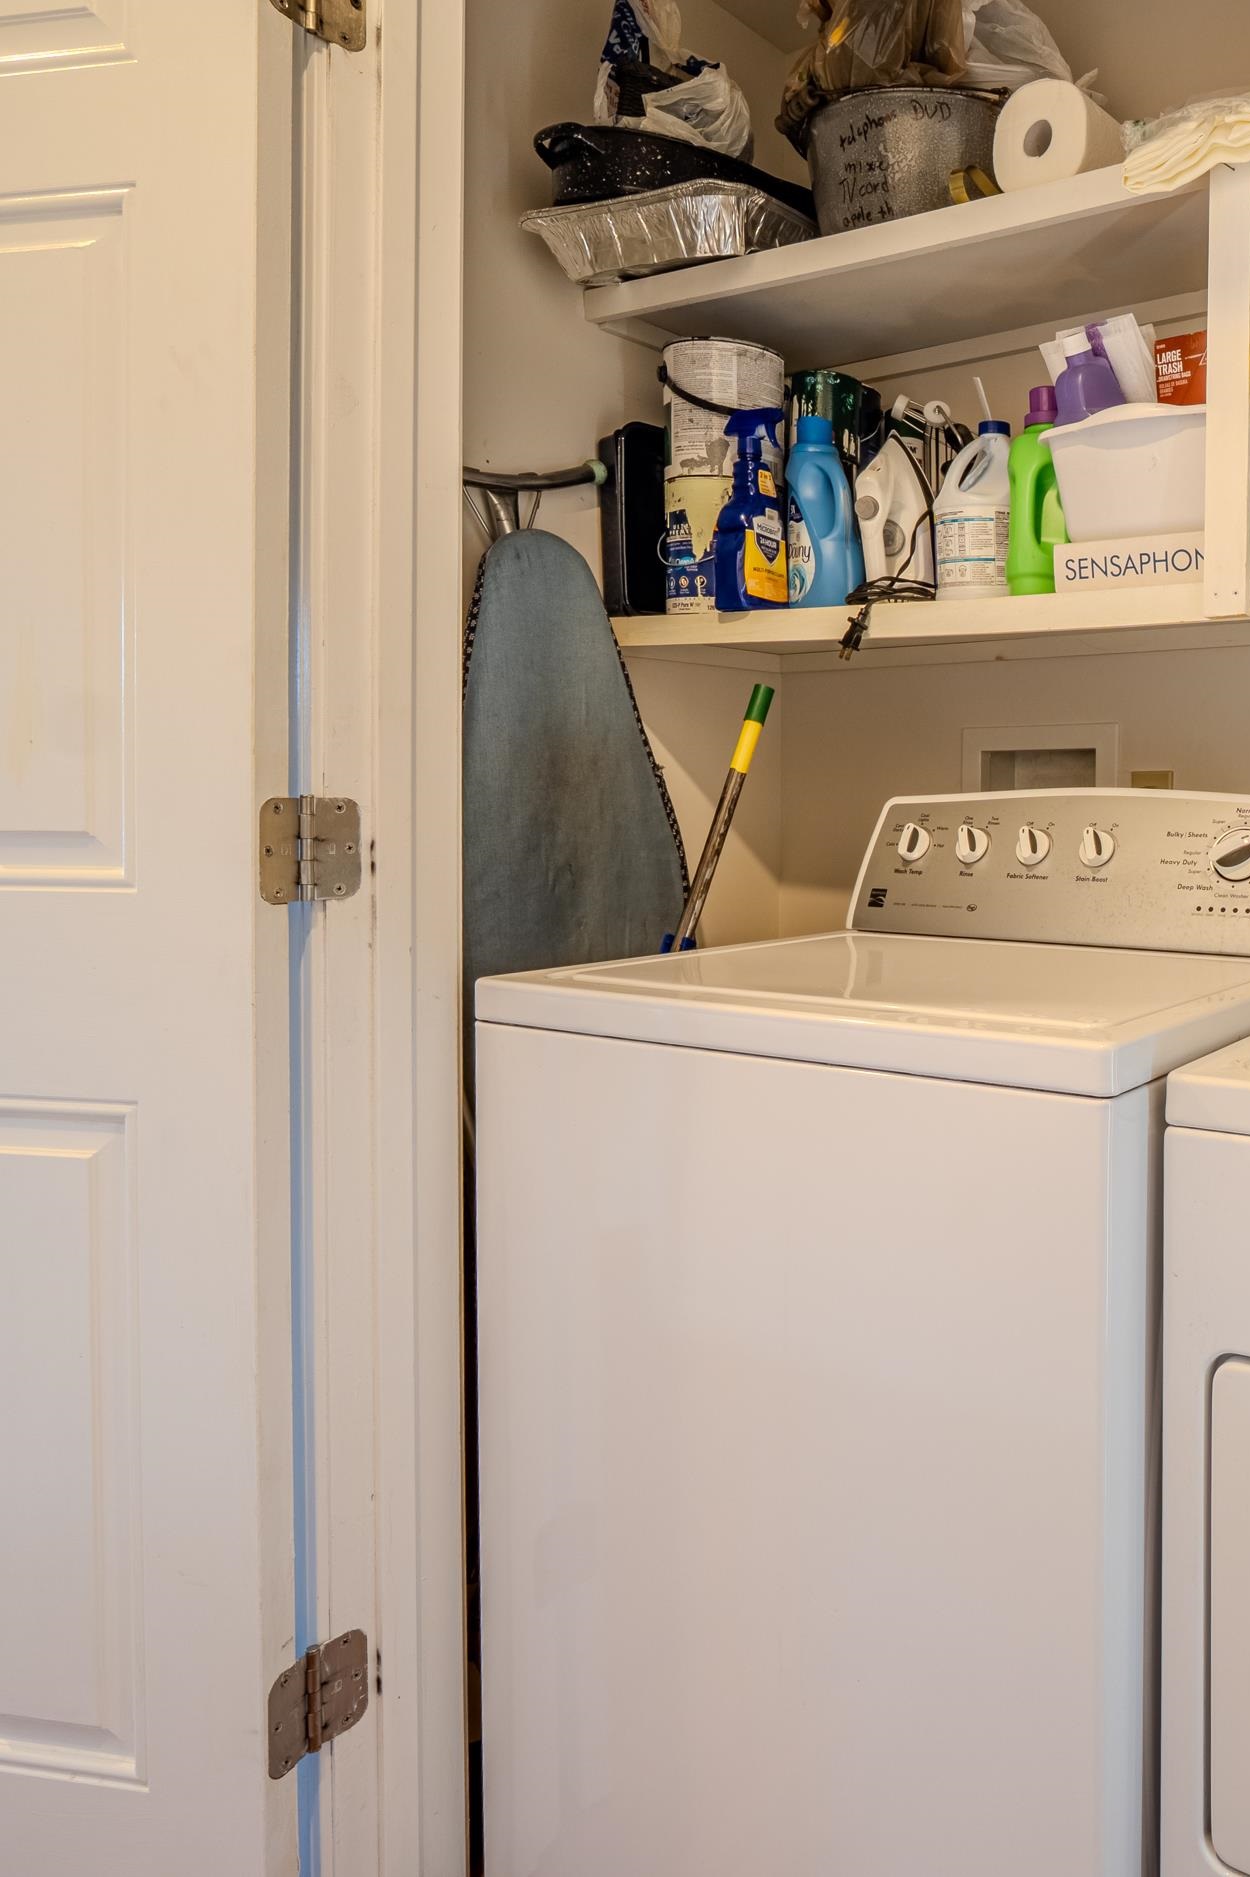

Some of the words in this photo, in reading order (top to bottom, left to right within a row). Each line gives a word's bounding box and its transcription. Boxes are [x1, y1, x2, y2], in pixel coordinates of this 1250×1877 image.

[911, 99, 951, 121] DVD
[1157, 349, 1182, 365] LARGE
[1158, 360, 1183, 376] TRASH
[1166, 831, 1184, 839] Bulky
[1182, 859, 1197, 867] Duty
[1177, 883, 1194, 891] Deep
